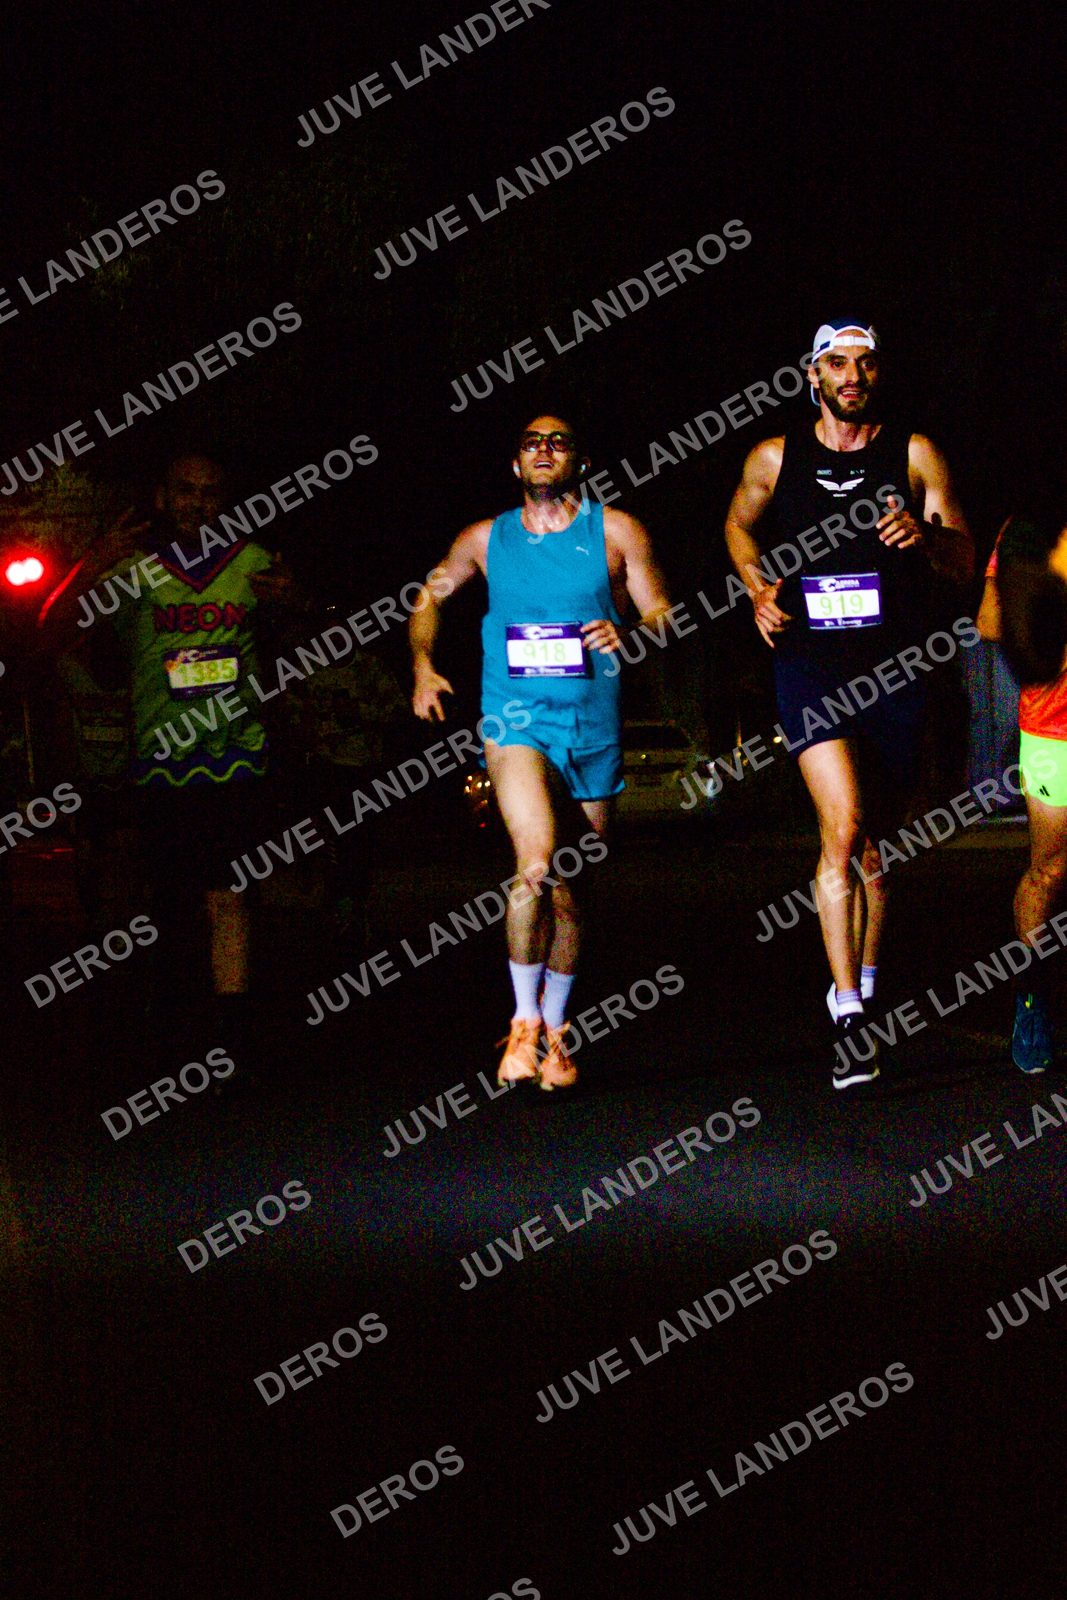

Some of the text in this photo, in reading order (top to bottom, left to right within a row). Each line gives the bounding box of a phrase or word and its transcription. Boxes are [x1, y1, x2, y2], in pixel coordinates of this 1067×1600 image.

[820, 593, 865, 617] 919
[153, 603, 249, 634] NEON
[523, 642, 567, 663] 918
